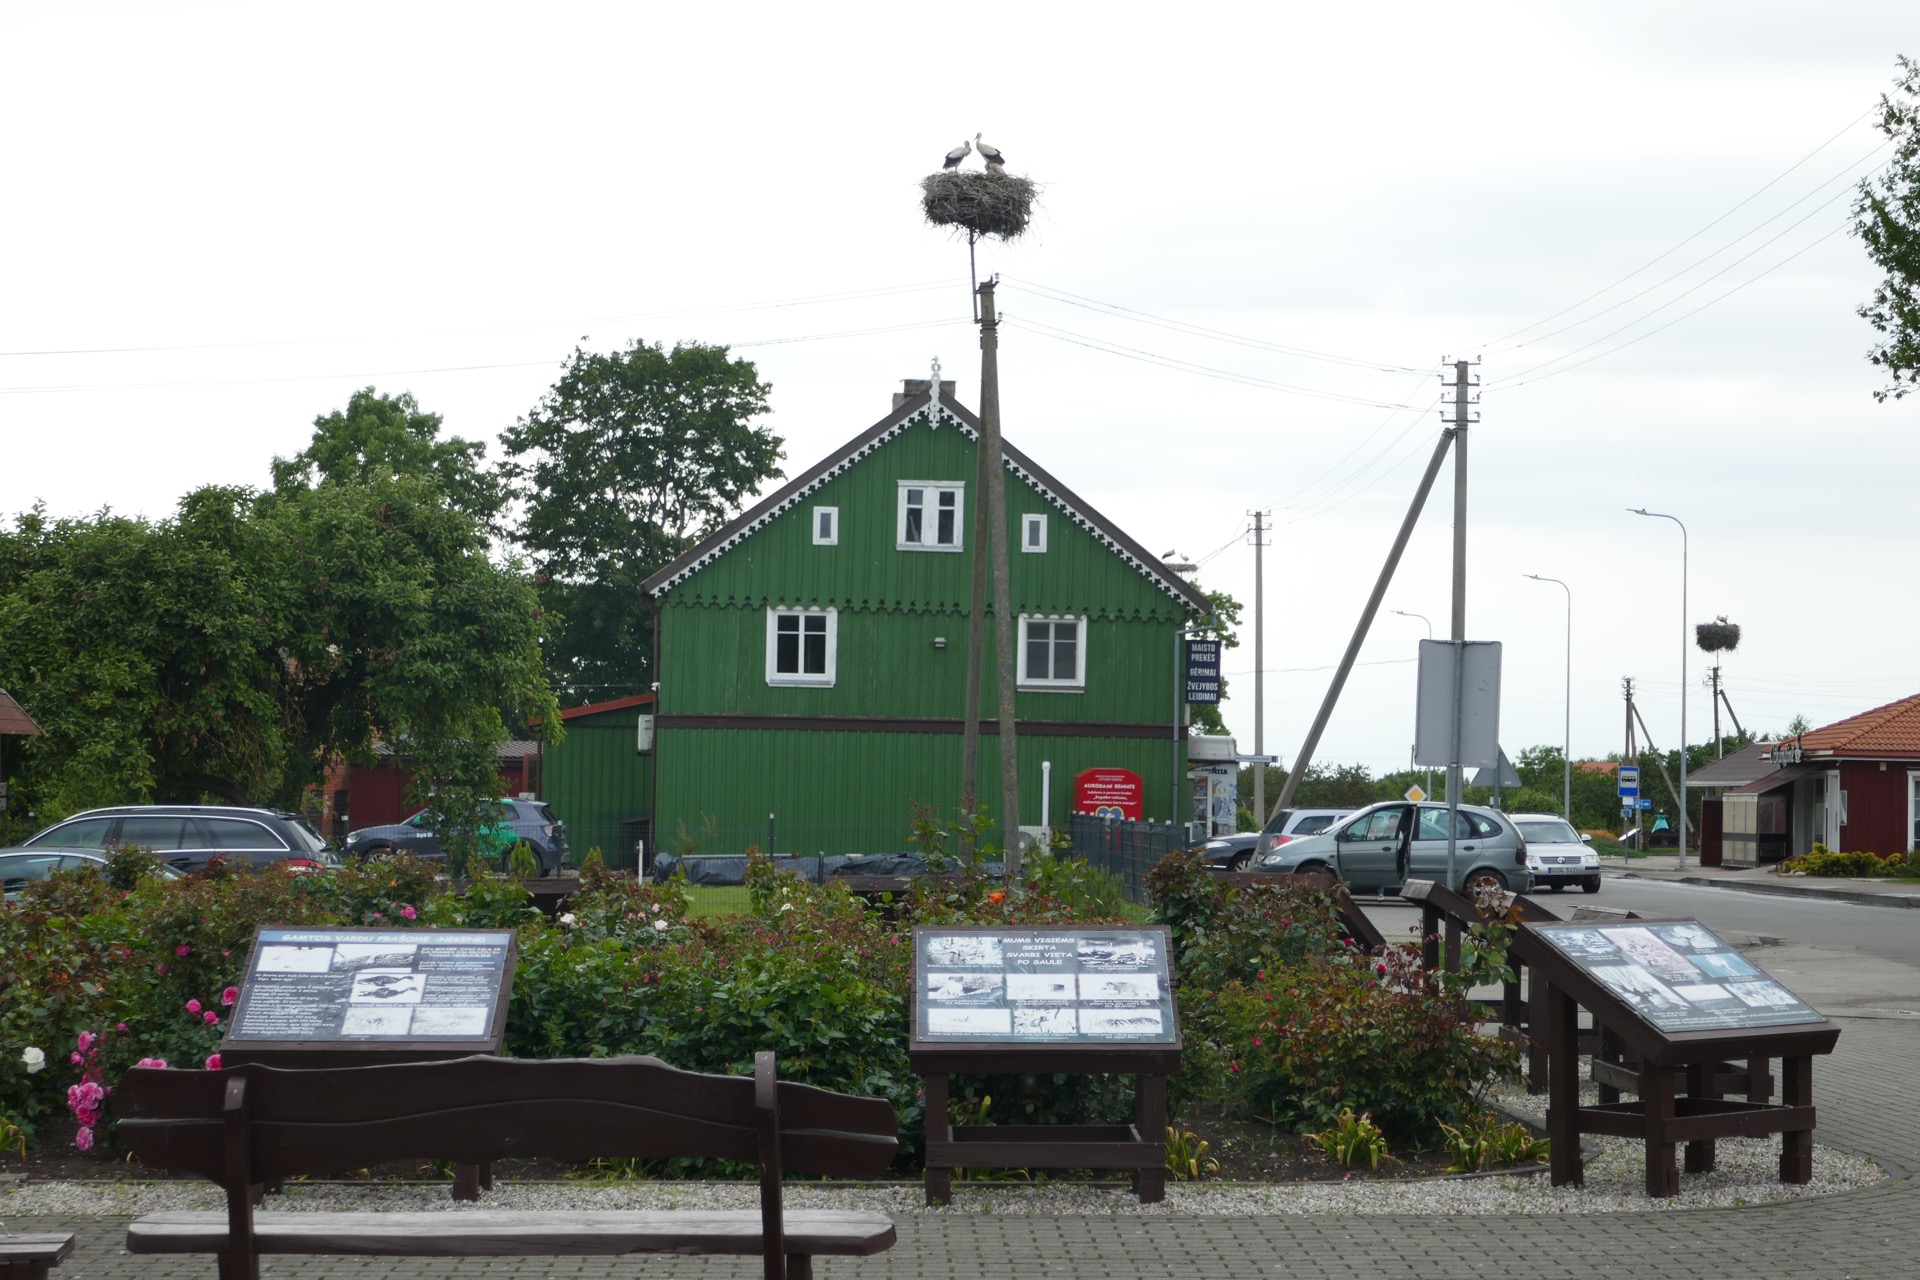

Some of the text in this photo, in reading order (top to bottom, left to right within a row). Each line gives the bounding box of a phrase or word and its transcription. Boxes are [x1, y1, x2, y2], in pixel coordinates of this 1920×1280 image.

[1192, 644, 1216, 652] MAISTO
[1191, 652, 1216, 662] PREKĖS
[1190, 667, 1216, 676] GĖRIMAI
[1187, 680, 1218, 690] ŽVEJYBOS
